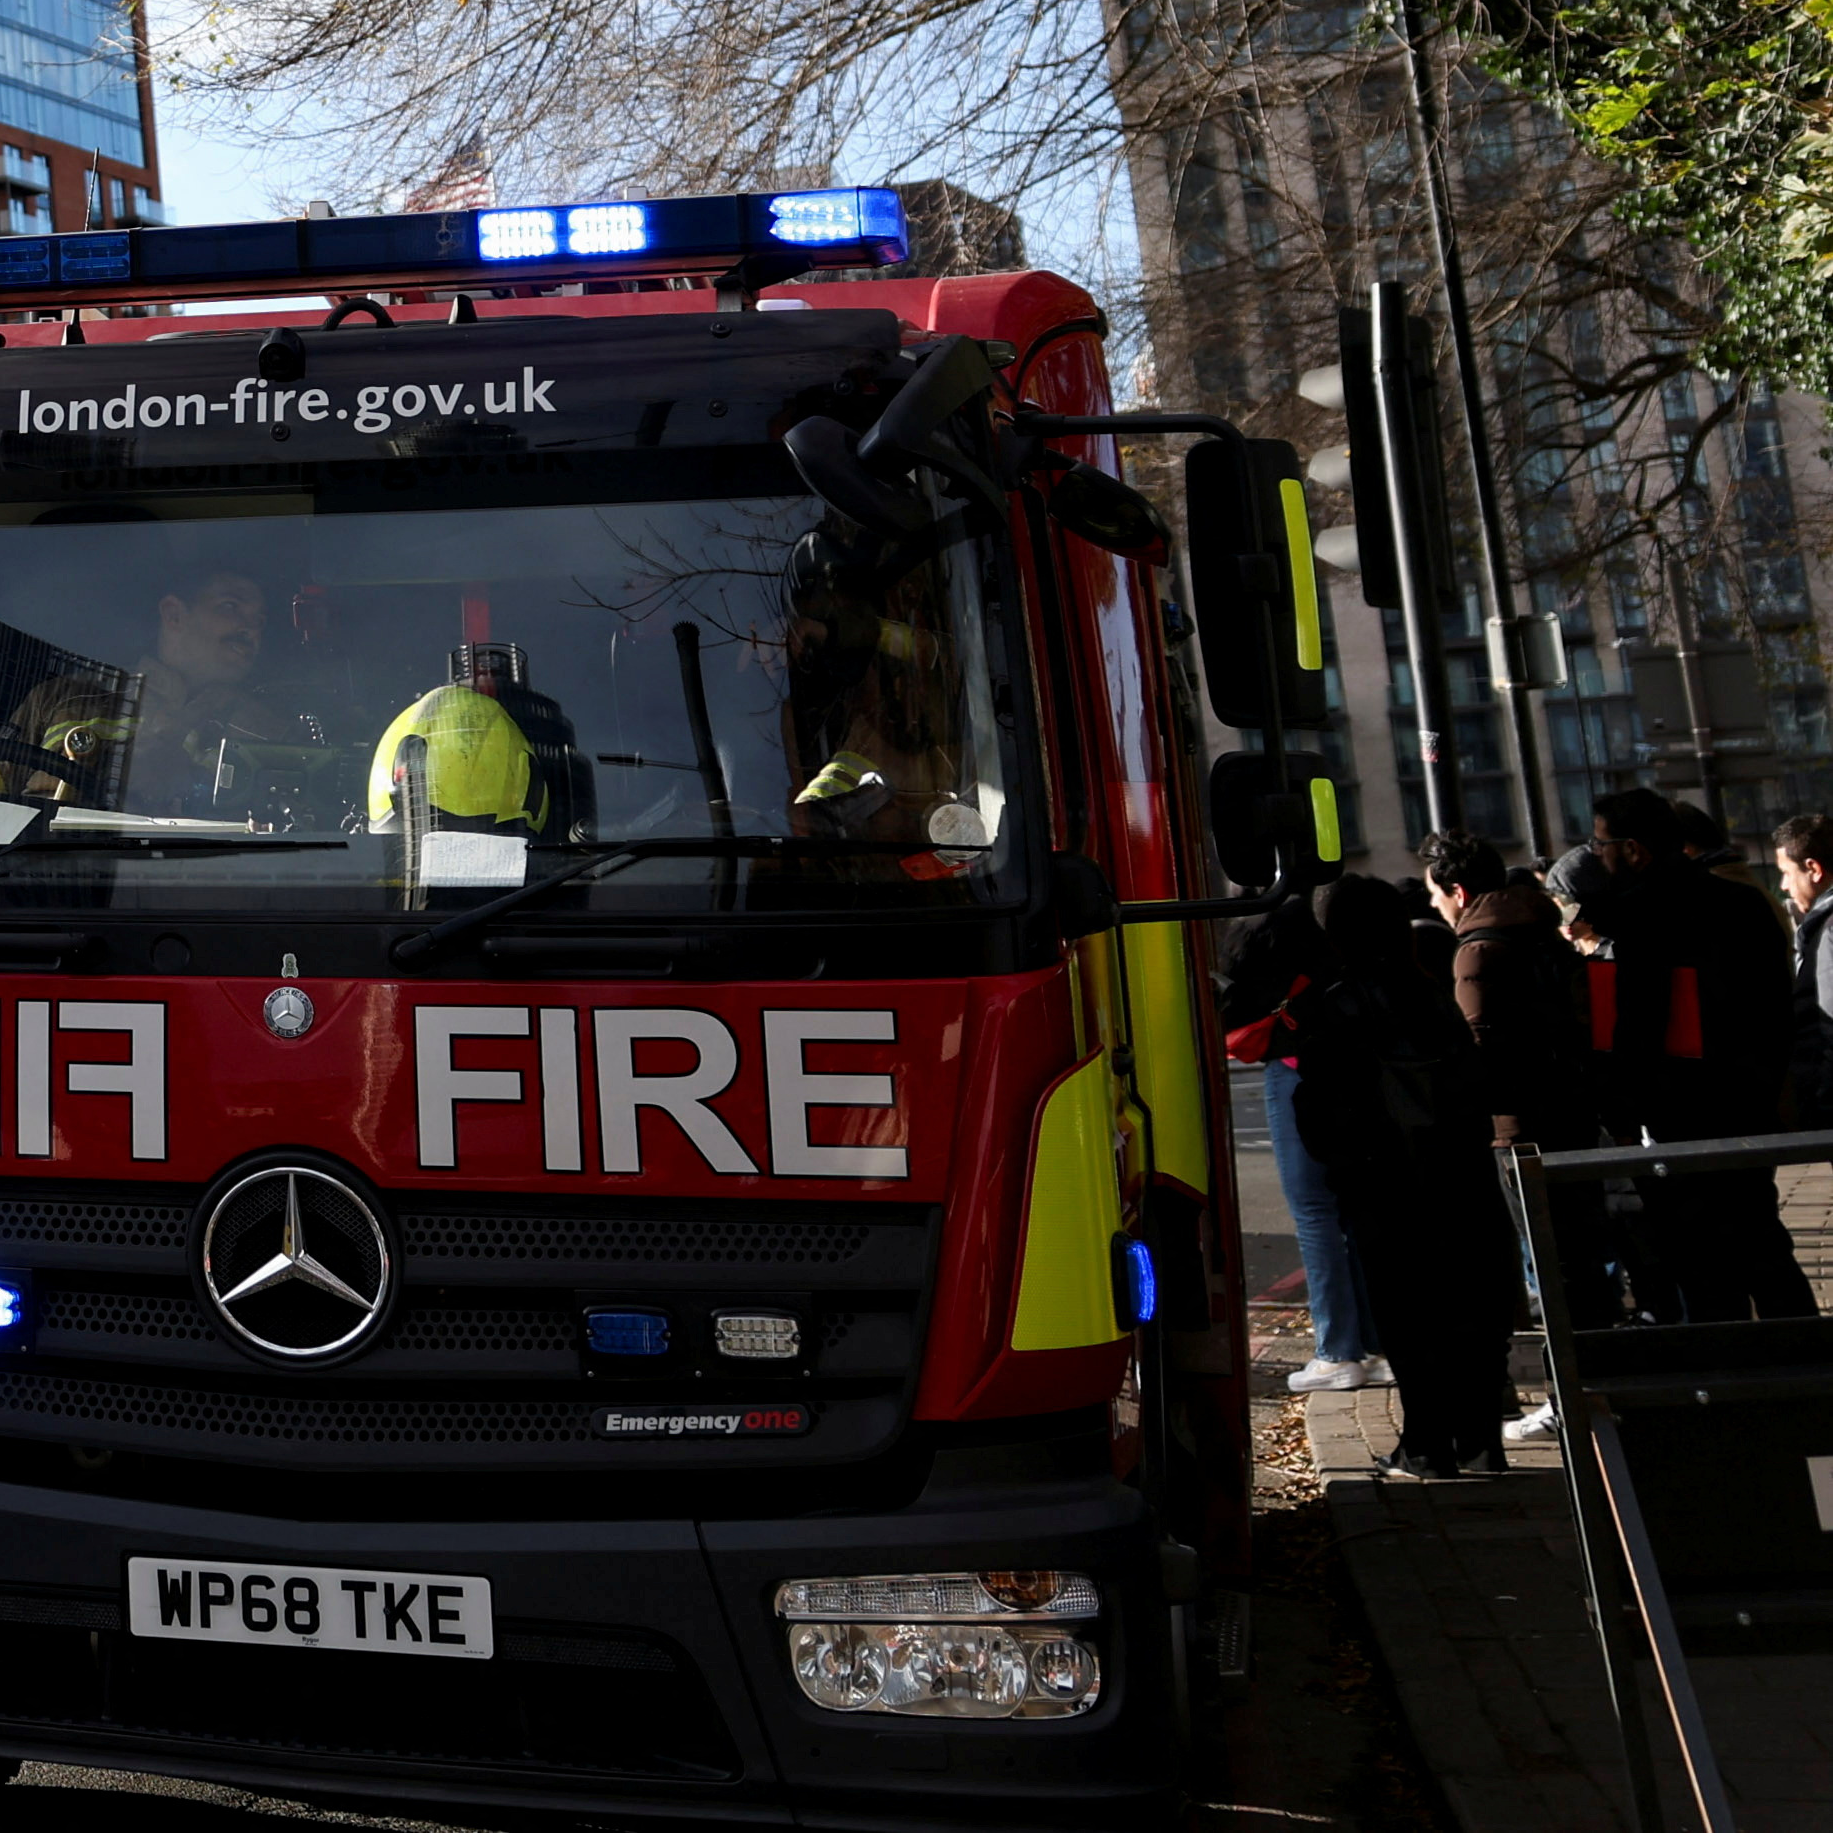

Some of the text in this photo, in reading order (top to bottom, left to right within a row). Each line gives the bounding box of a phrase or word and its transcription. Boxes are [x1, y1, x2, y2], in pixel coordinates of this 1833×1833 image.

[18, 365, 557, 434] london-fire.gov.uk
[414, 1004, 909, 1178] FIRE
[606, 1411, 801, 1435] Emergency one
[157, 1568, 467, 1646] WP68 TKE
